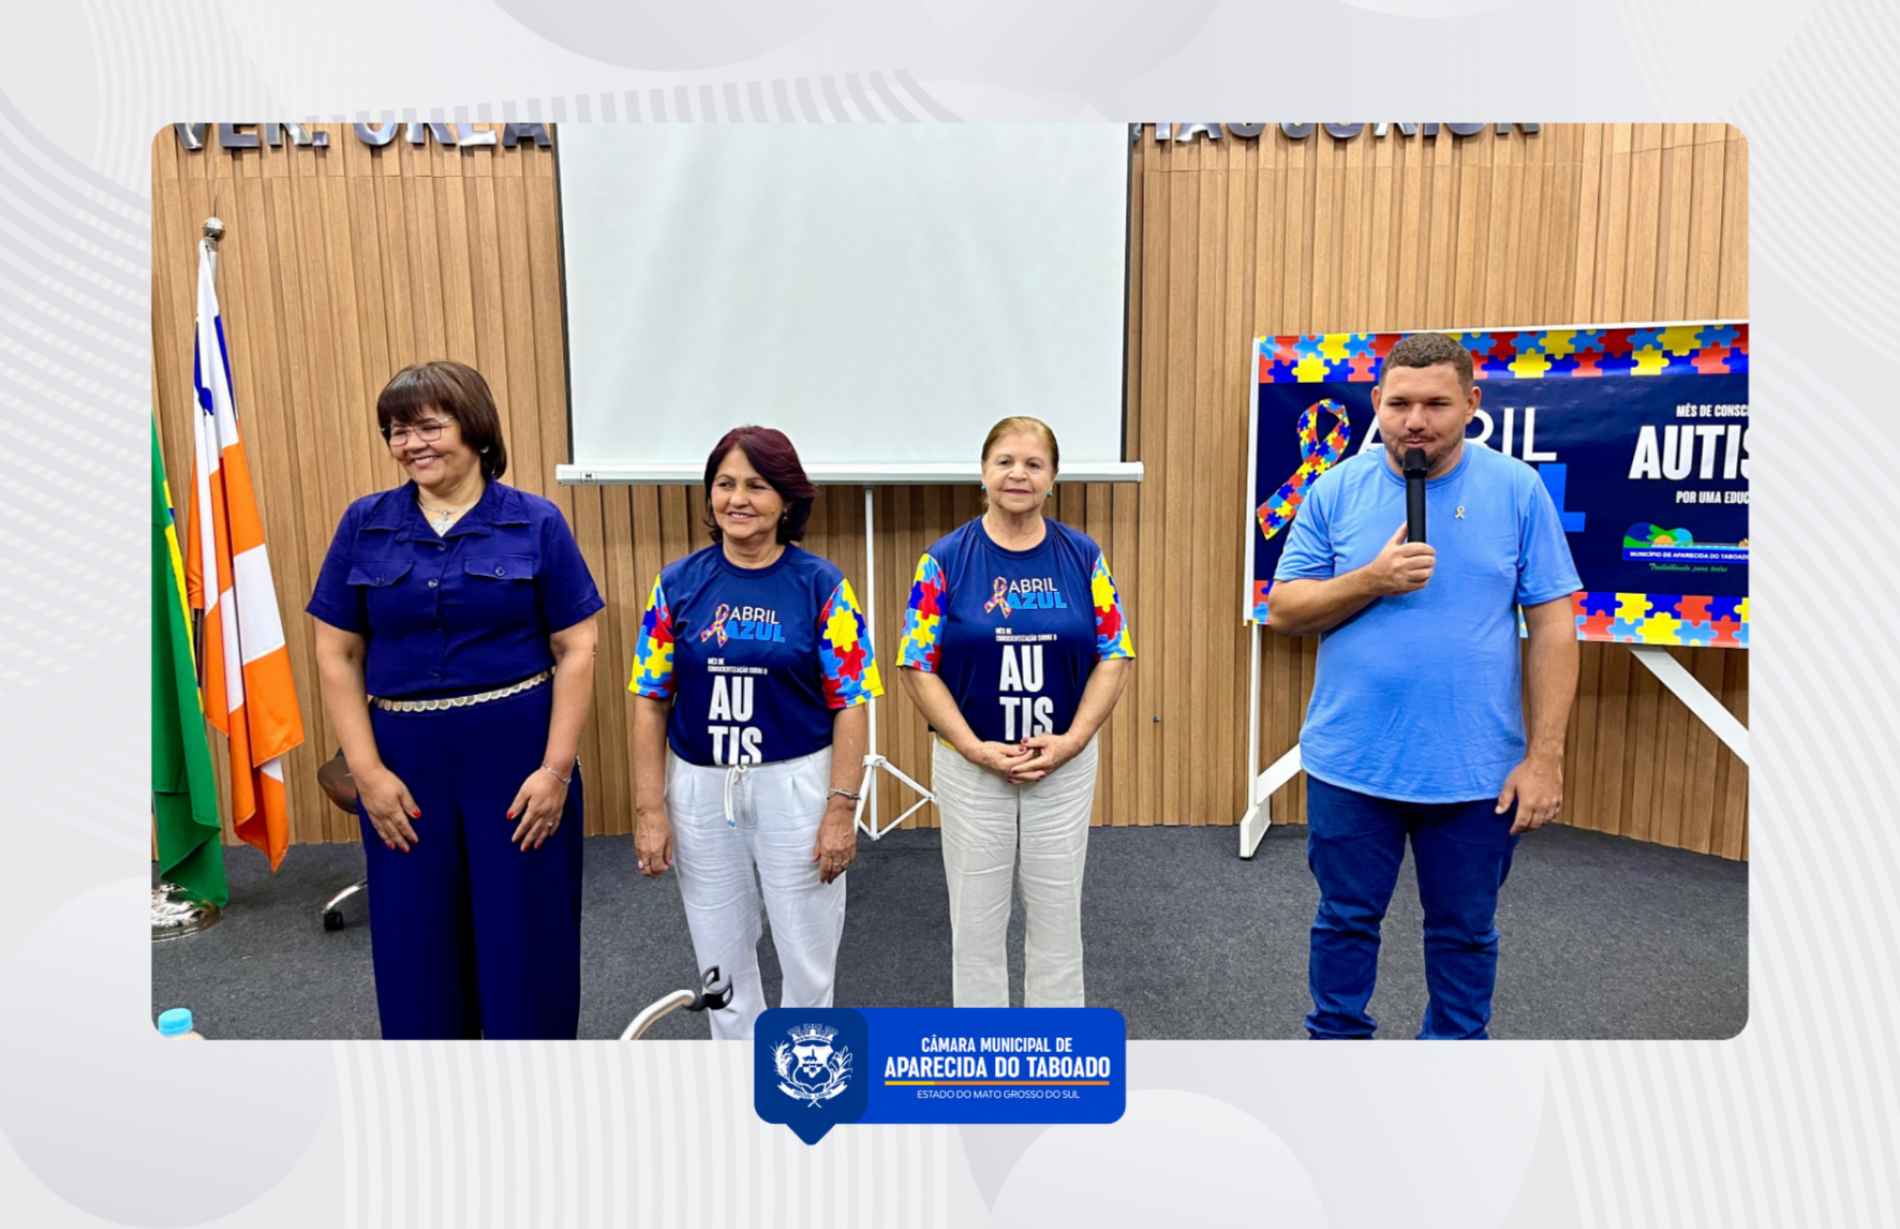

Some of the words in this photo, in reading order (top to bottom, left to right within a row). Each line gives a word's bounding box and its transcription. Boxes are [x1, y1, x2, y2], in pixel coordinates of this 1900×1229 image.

[1676, 402, 1697, 418] MÊS
[1699, 404, 1713, 417] DE
[1676, 491, 1697, 504] POR
[1698, 491, 1722, 504] UMA
[1008, 577, 1058, 594] ABRIL
[1006, 591, 1067, 610] AZUL
[729, 606, 780, 625] ABRIL
[725, 620, 786, 643] AZUL
[999, 645, 1043, 693] AU
[708, 675, 753, 722] AU
[999, 696, 1054, 741] TIS
[708, 725, 762, 765] TIS
